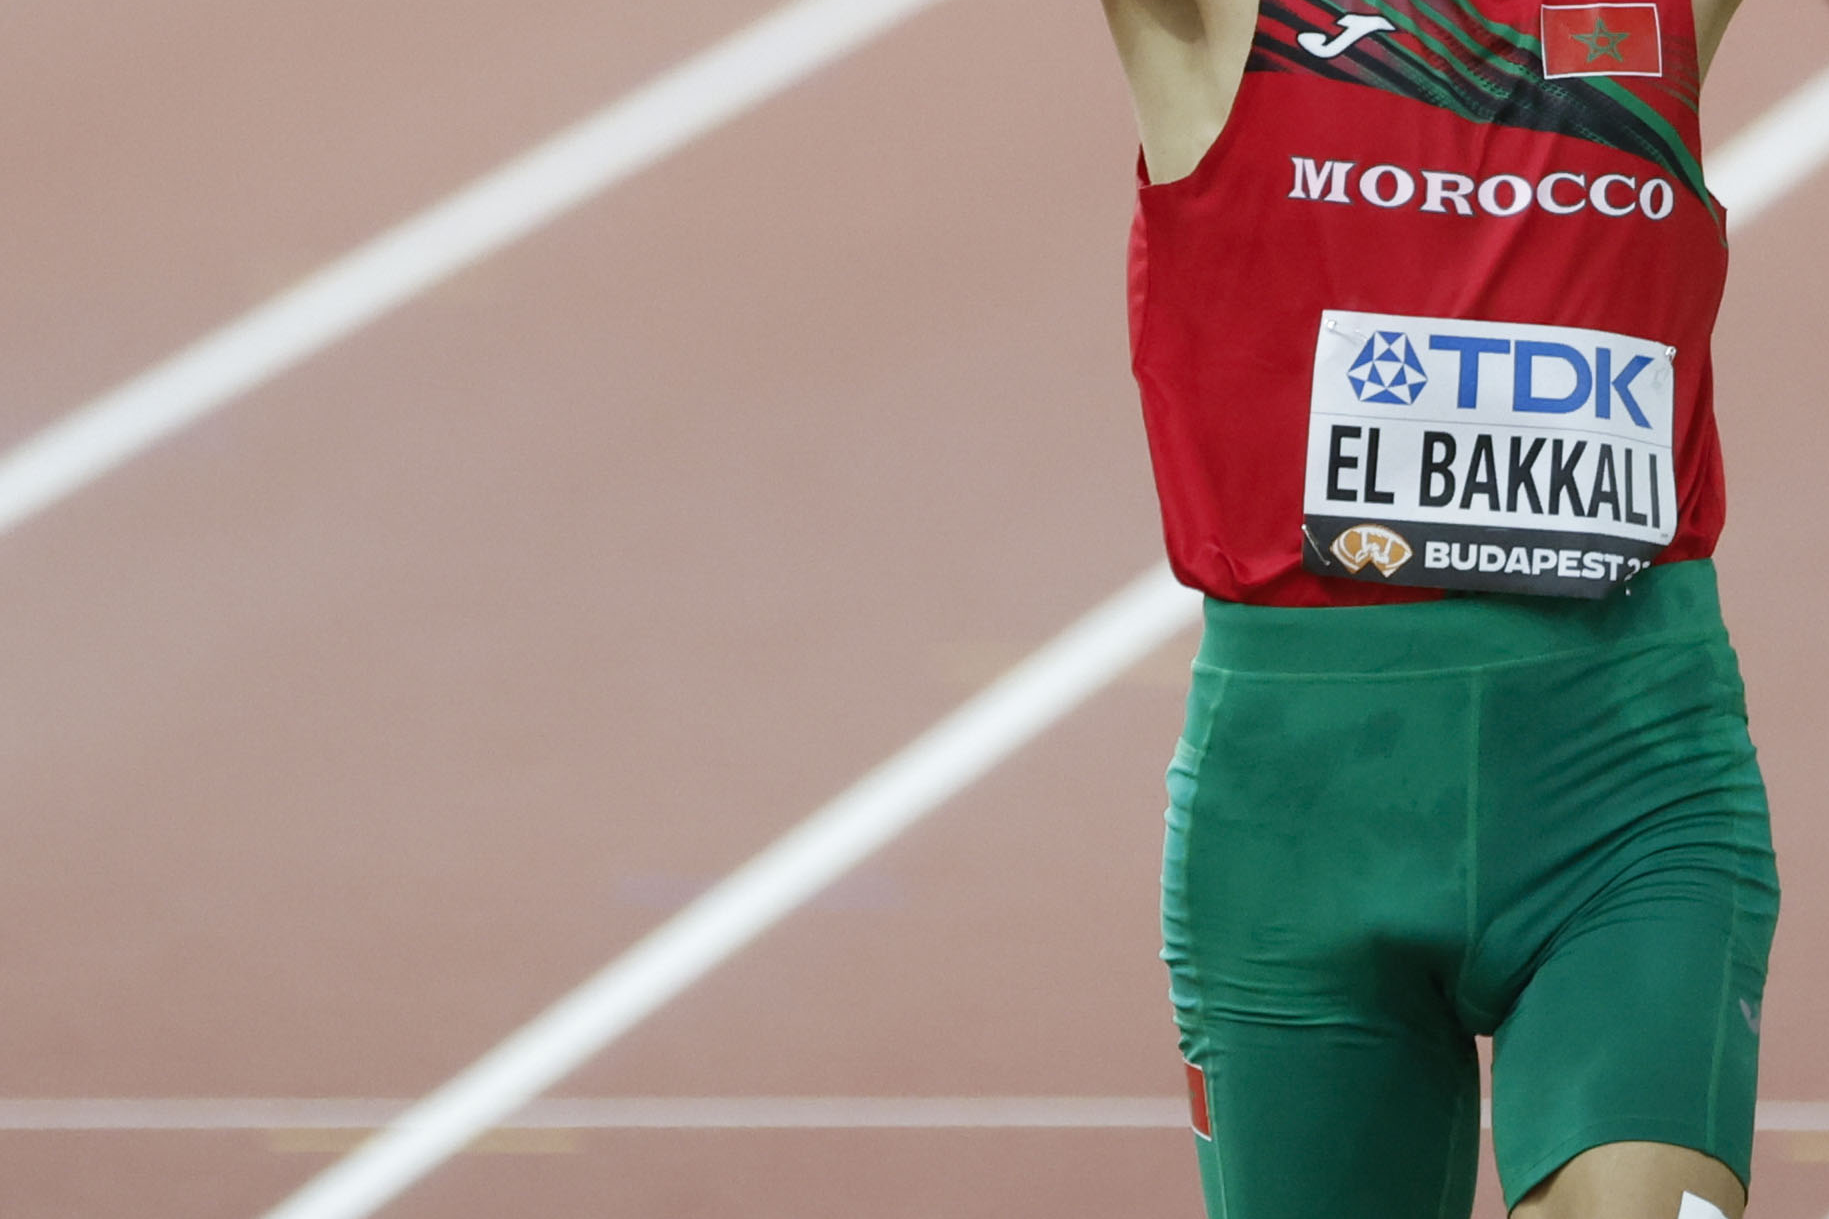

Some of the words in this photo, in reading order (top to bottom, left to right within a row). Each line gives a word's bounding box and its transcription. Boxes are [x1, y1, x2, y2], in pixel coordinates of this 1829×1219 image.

[1288, 156, 1675, 220] MOROCCO
[1428, 334, 1656, 430] TDK
[1326, 424, 1395, 504] EL
[1419, 430, 1661, 530] BAKKALI
[1424, 541, 1624, 581] BUDAPEST
